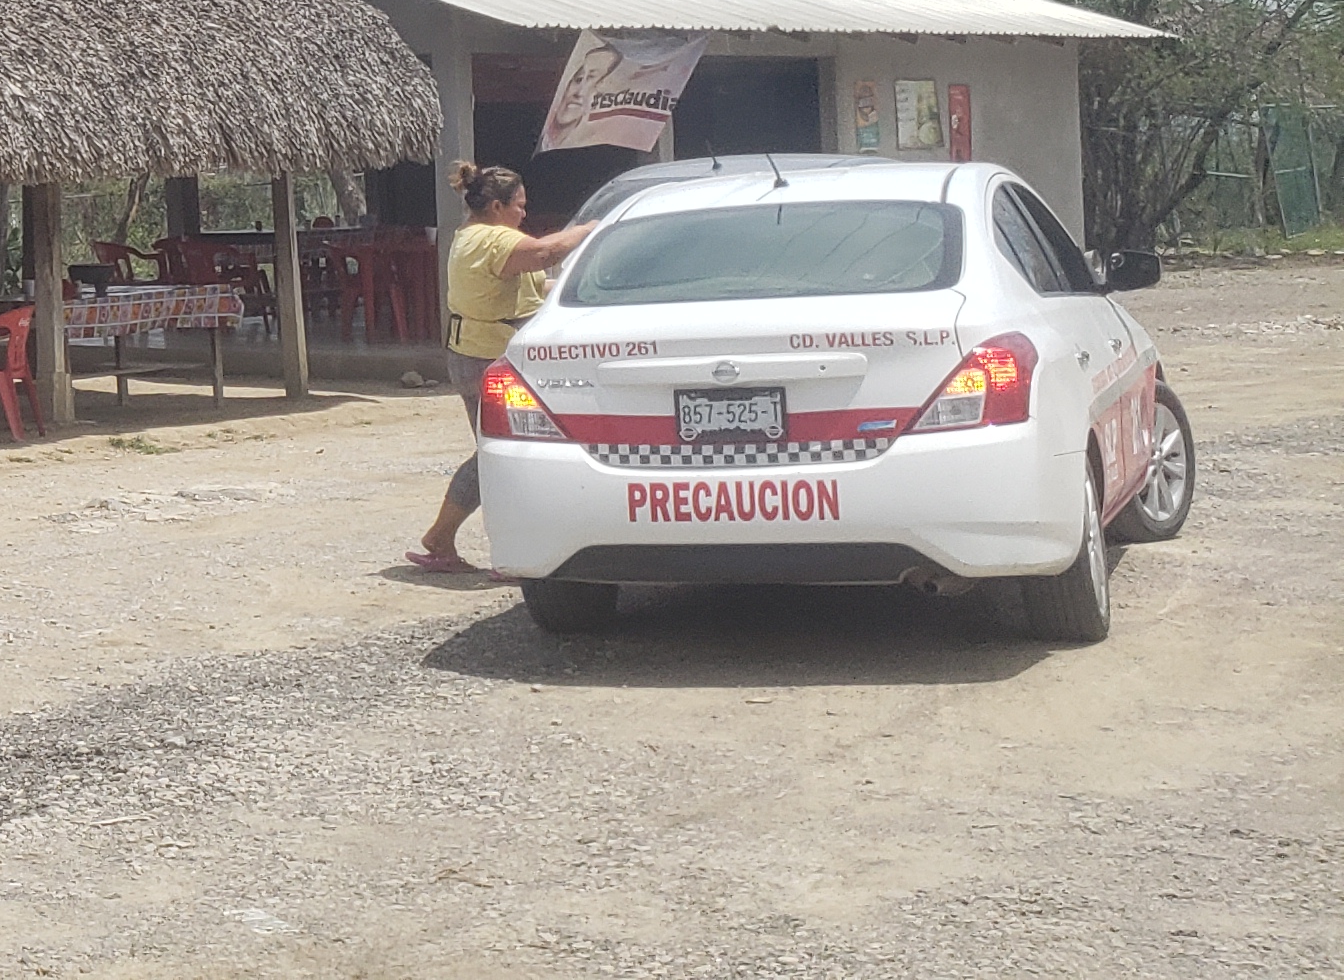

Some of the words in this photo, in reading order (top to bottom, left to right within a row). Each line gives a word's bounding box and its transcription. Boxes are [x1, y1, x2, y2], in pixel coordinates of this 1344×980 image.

[527, 342, 620, 361] COLECTIVO
[625, 340, 658, 357] 261
[790, 333, 819, 349] CD.
[825, 331, 894, 348] VALLES
[906, 330, 956, 346] S.L.P.
[682, 401, 779, 424] 857-525-T
[627, 479, 840, 522] PRECAUCION
